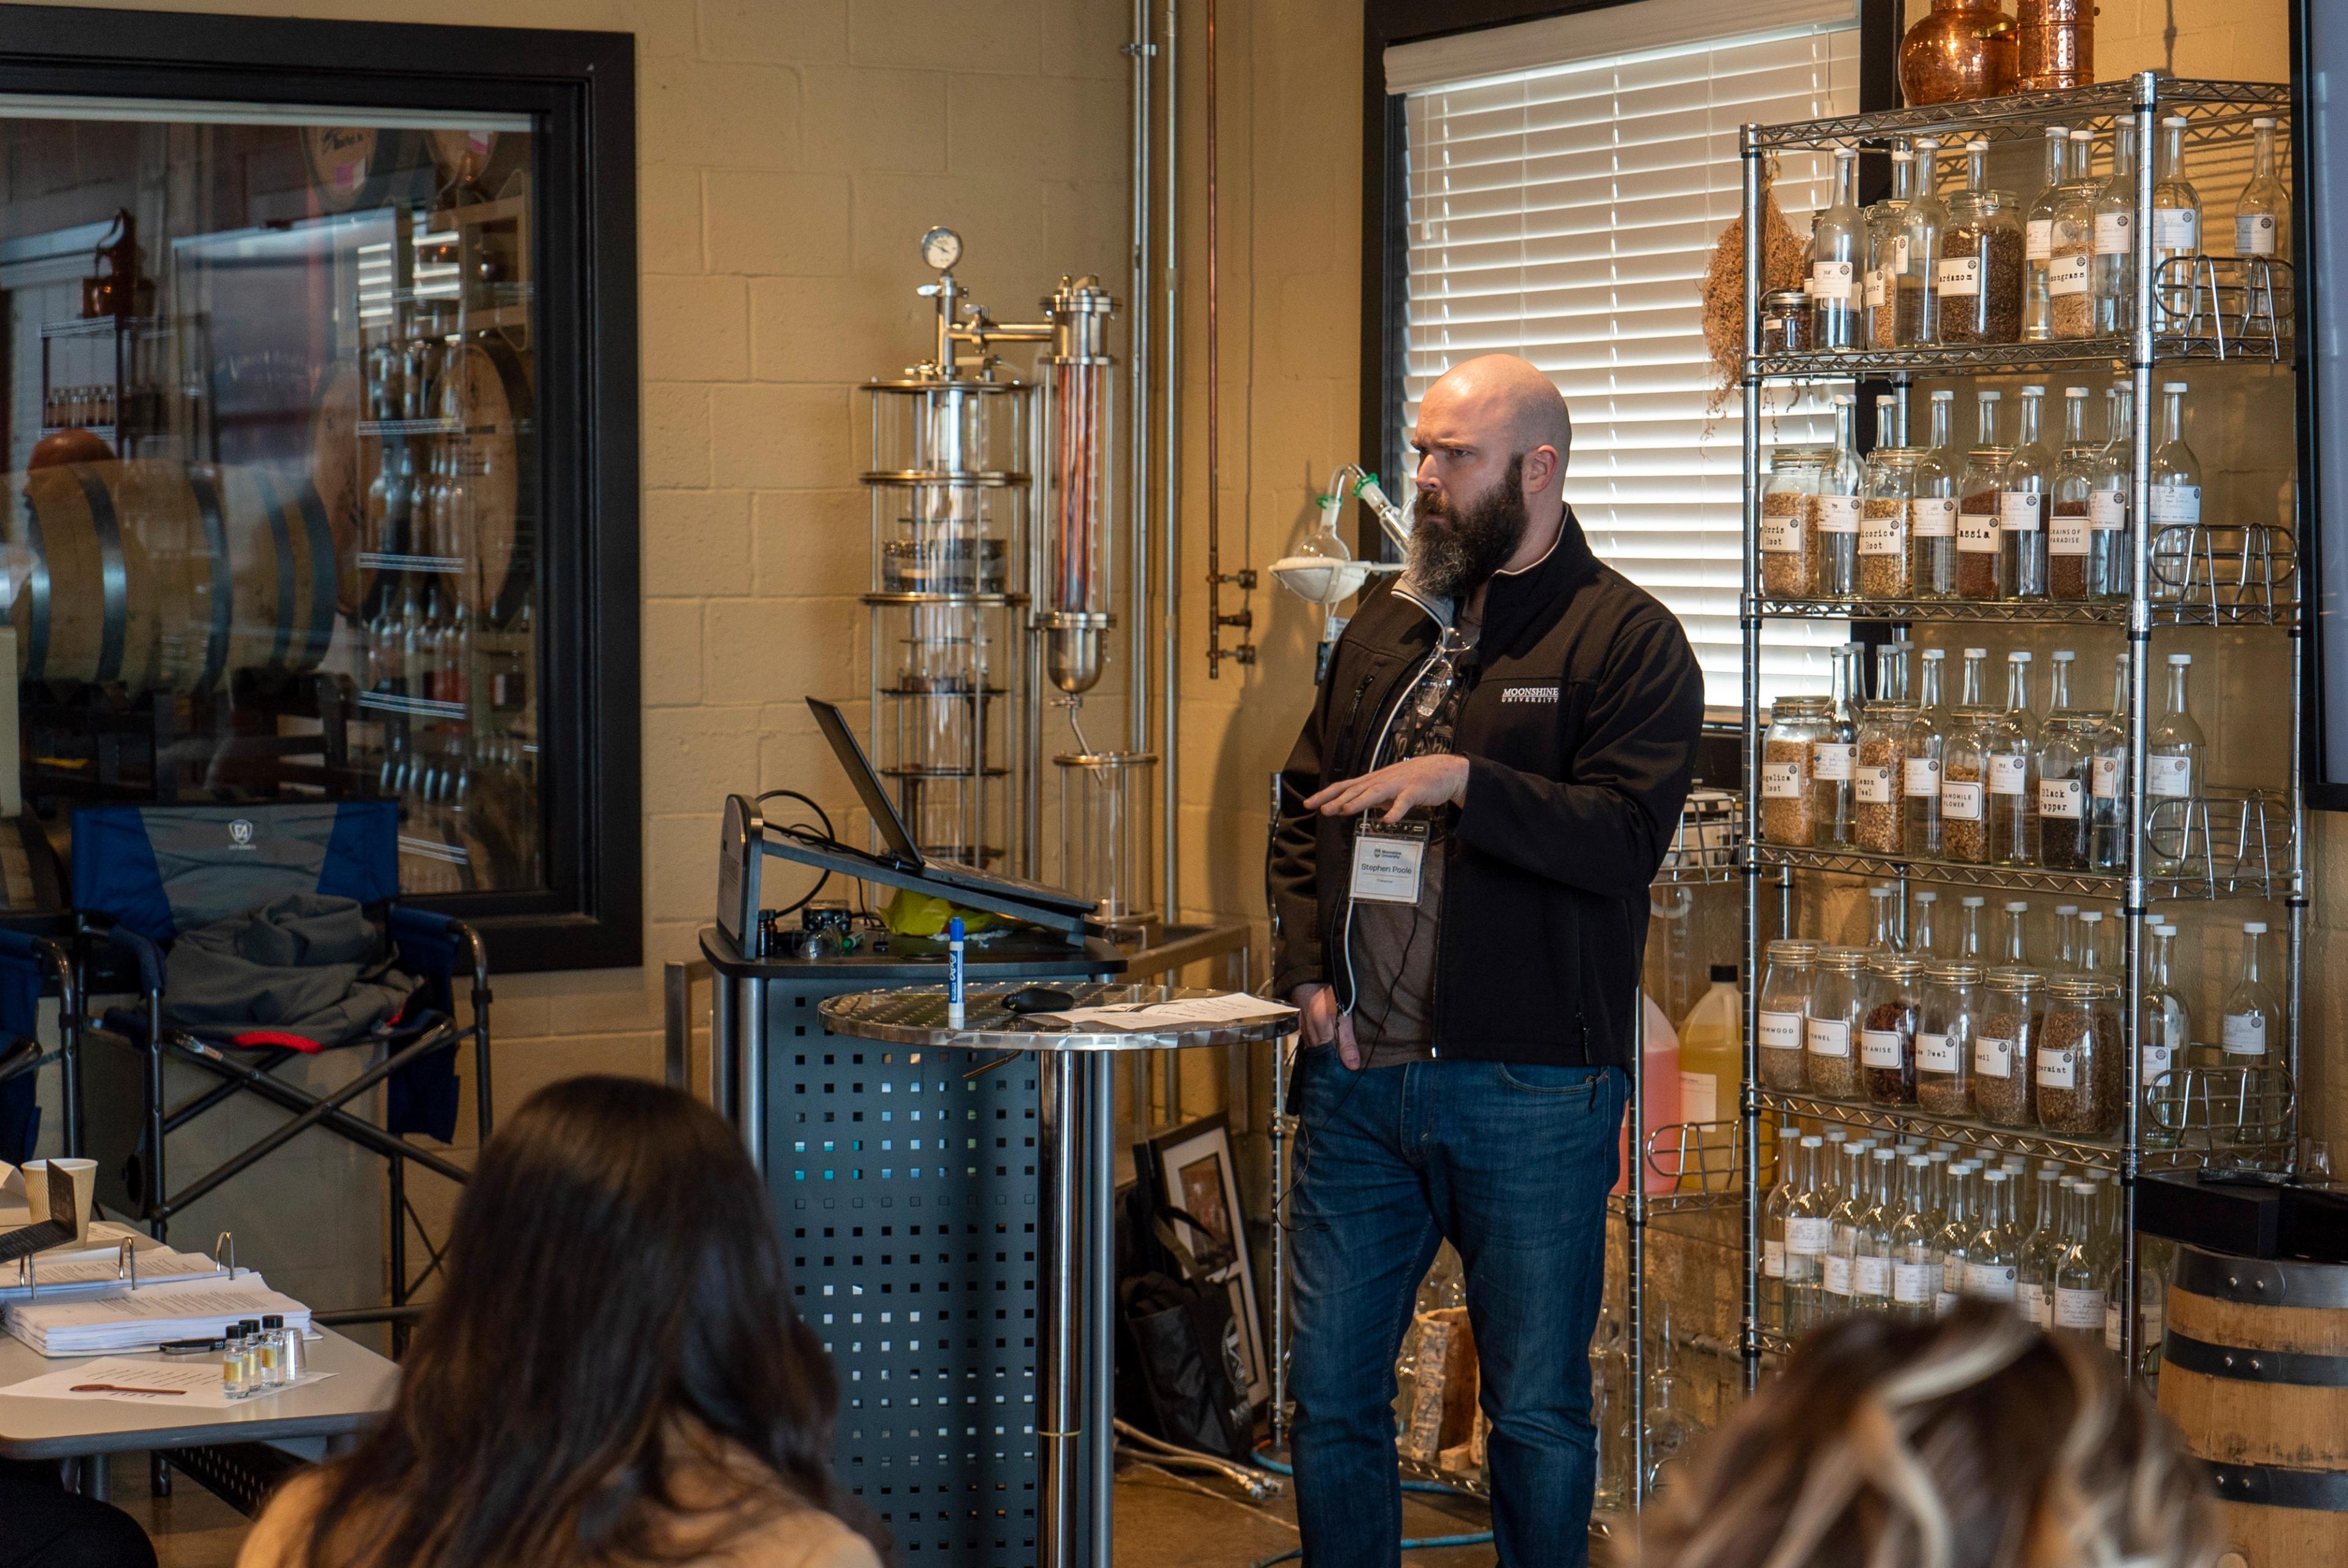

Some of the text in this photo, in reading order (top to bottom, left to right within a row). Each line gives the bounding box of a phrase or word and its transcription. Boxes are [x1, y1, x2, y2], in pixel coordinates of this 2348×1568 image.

[1939, 273, 1973, 282] ardamom
[2050, 272, 2084, 282] mongrass
[1763, 525, 1784, 534] Orris
[1860, 529, 1895, 537] icorice
[1766, 537, 1782, 545] Root
[1865, 541, 1883, 550] Root
[1503, 687, 1559, 696] MOONSHINE
[1763, 773, 1790, 782] ngelica
[2042, 789, 2065, 798] Black
[2040, 801, 2067, 812] Pepper
[1361, 863, 1412, 875] Stephen Poole
[1809, 1032, 1831, 1042] FENNEL
[1927, 1050, 1946, 1058] Peel
[1977, 1053, 1990, 1062] asil
